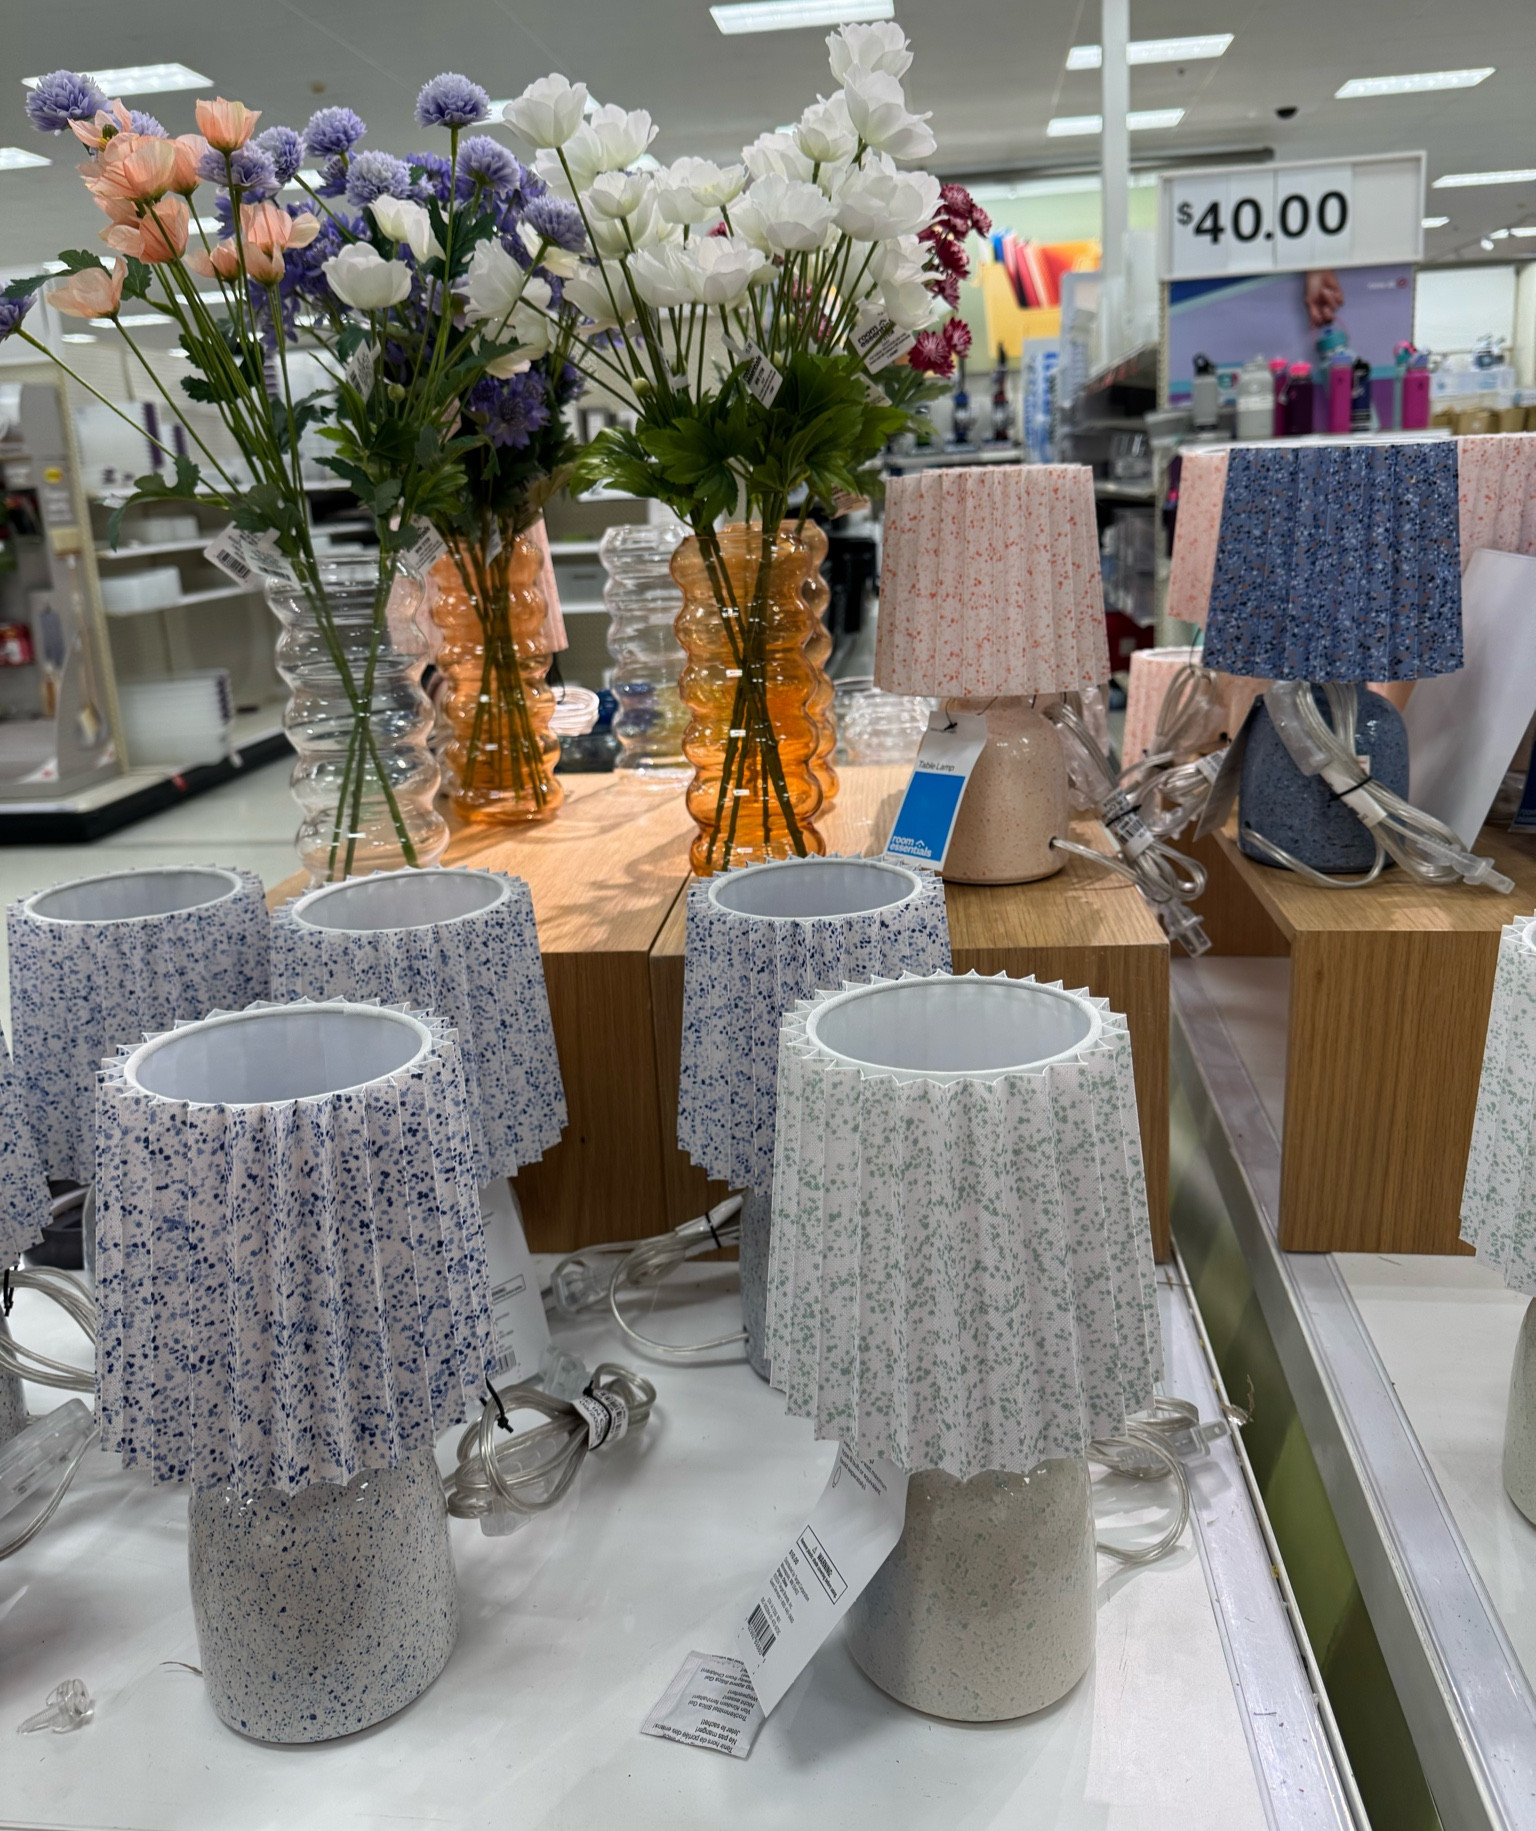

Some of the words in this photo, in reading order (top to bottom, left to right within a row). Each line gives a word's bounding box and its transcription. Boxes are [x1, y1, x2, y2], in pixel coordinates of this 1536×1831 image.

[1176, 190, 1349, 244] $40.00
[918, 761, 936, 771] Table
[936, 761, 955, 772] Lamp
[892, 836, 914, 846] room
[890, 842, 932, 858] essentials
[707, 1739, 720, 1747] hors
